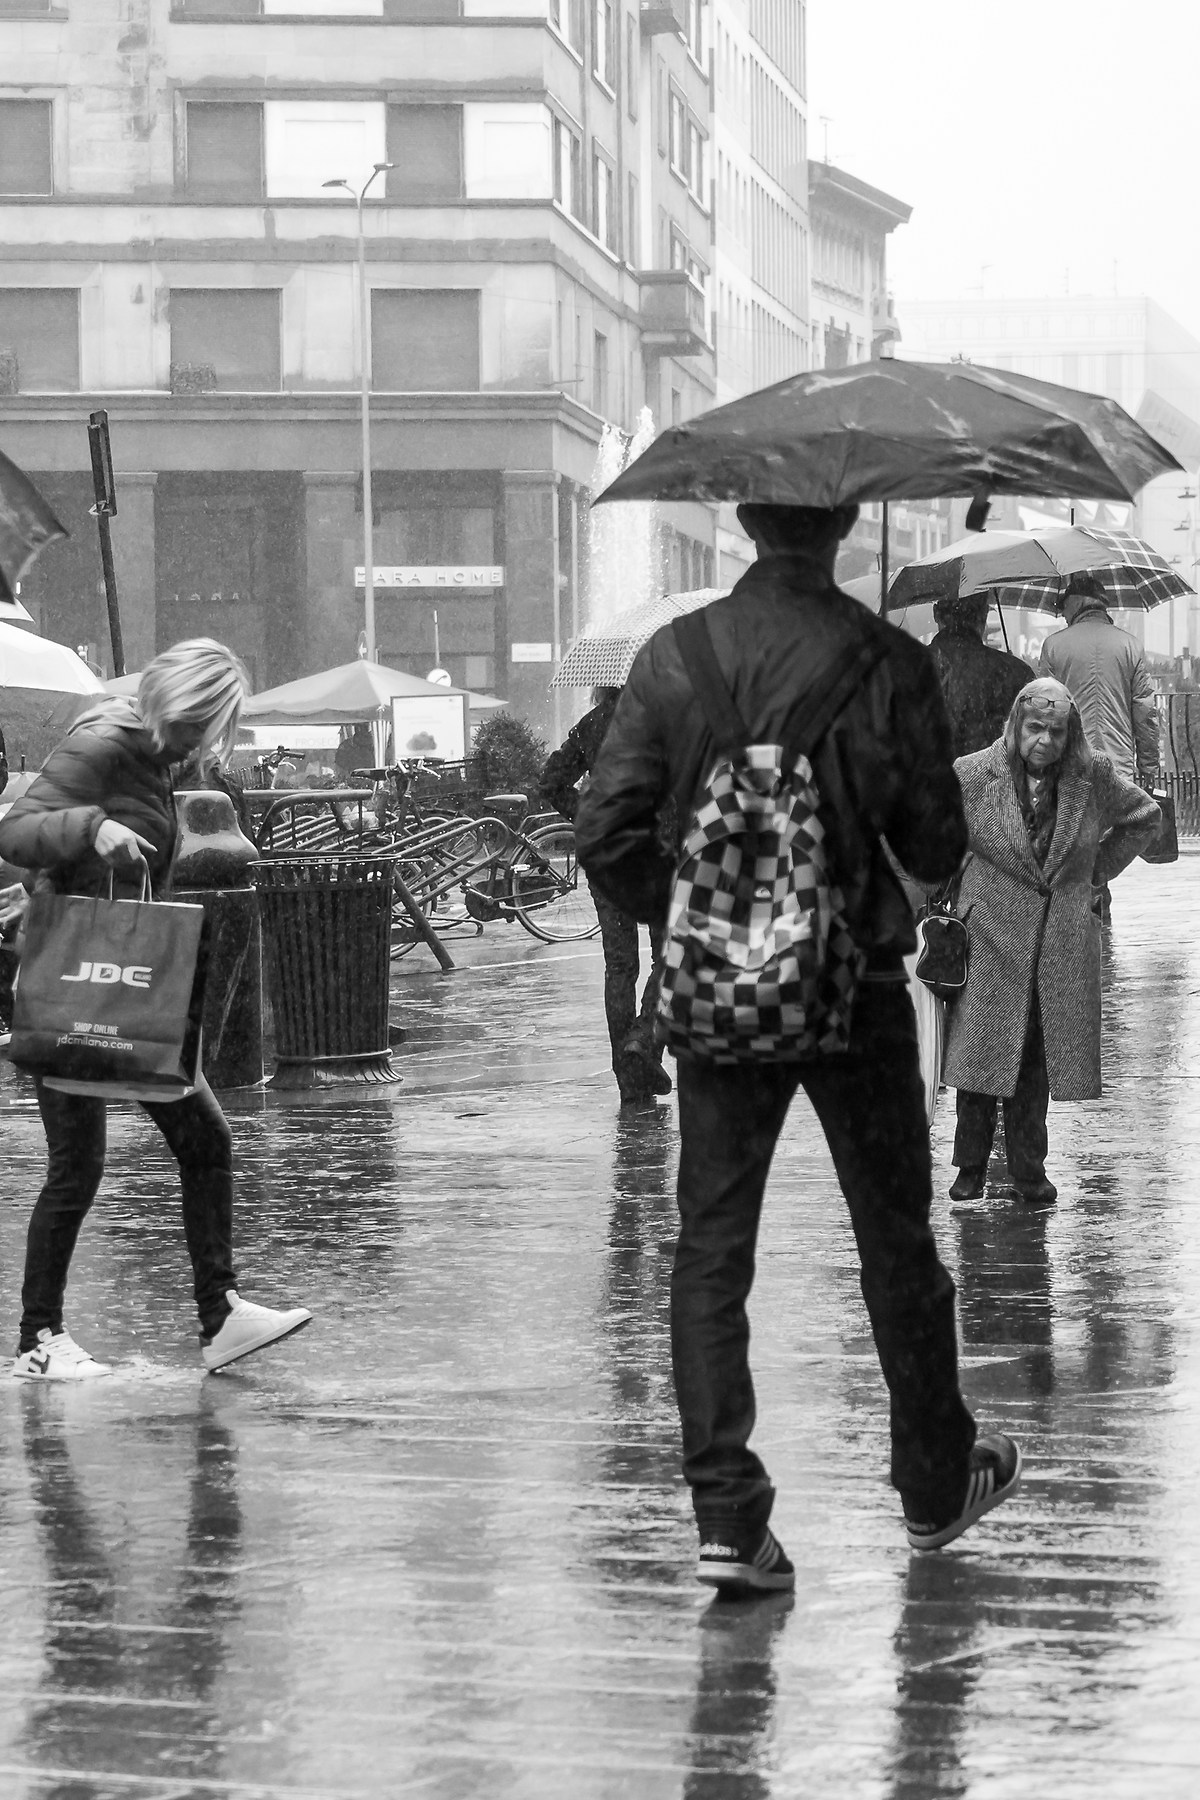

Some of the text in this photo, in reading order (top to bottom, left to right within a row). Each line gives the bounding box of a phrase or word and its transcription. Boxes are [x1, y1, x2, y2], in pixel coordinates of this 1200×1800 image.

[435, 572, 501, 584] HOME
[60, 962, 153, 988] JDC
[73, 1022, 119, 1036] SHOP ONLINE
[56, 1034, 134, 1051] jdcmilano.com
